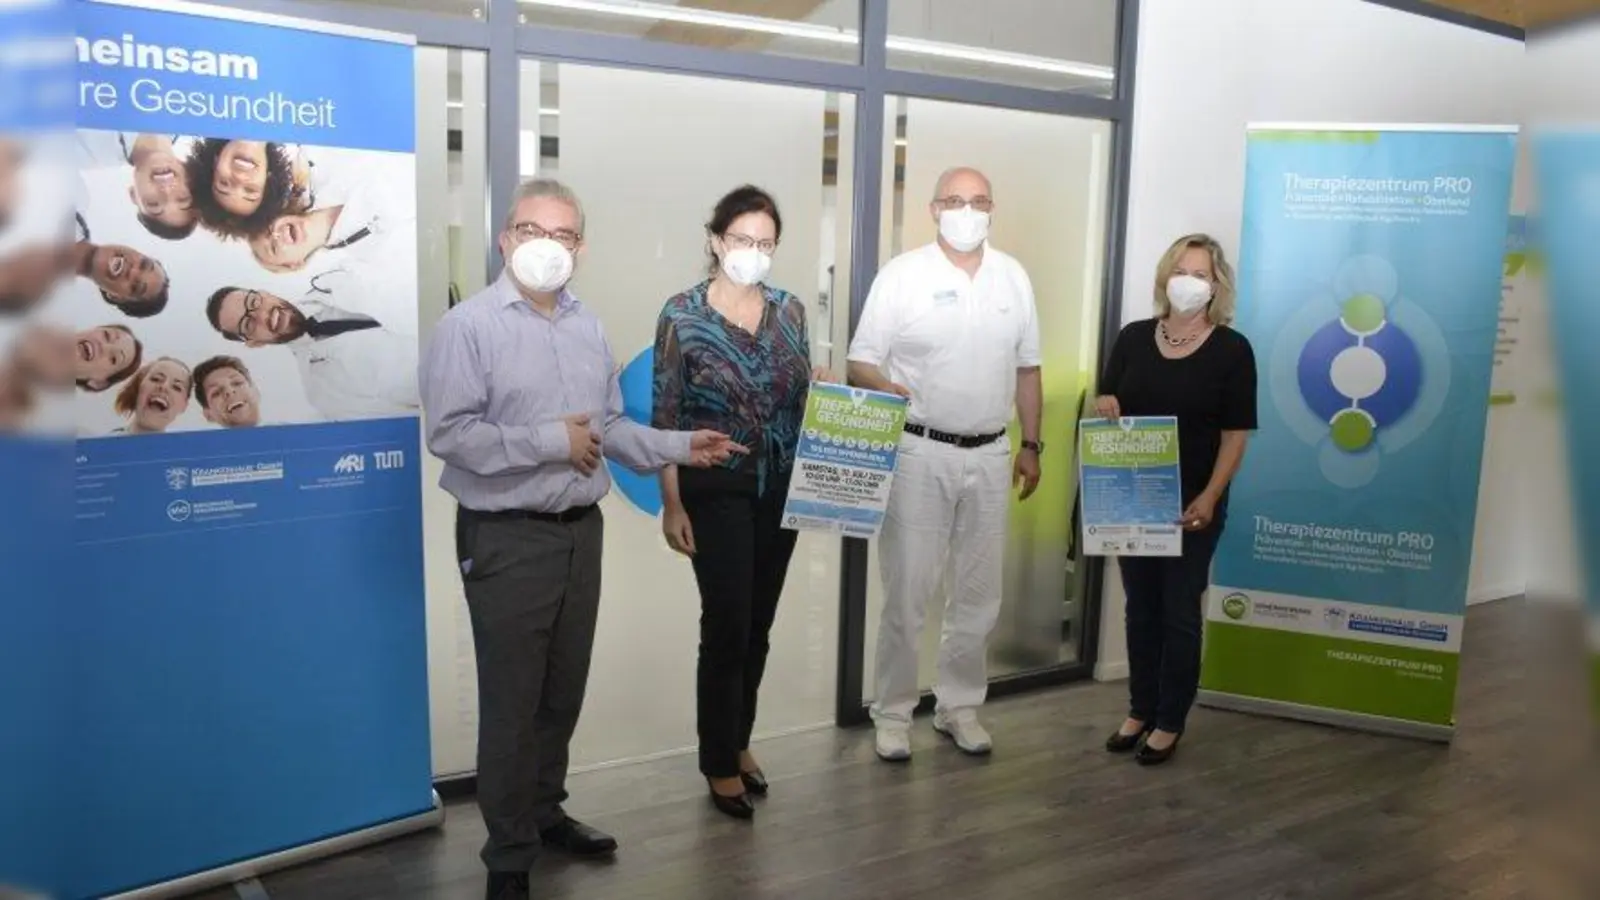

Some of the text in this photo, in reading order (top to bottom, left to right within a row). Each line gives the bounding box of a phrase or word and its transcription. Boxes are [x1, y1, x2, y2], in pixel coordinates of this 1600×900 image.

[130, 78, 336, 128] Gesundheit
[1284, 172, 1472, 194] Therapiezentrum PRO
[816, 410, 893, 433] GESUNDHEIT
[1254, 515, 1435, 550] Therapiezentrum PRO
